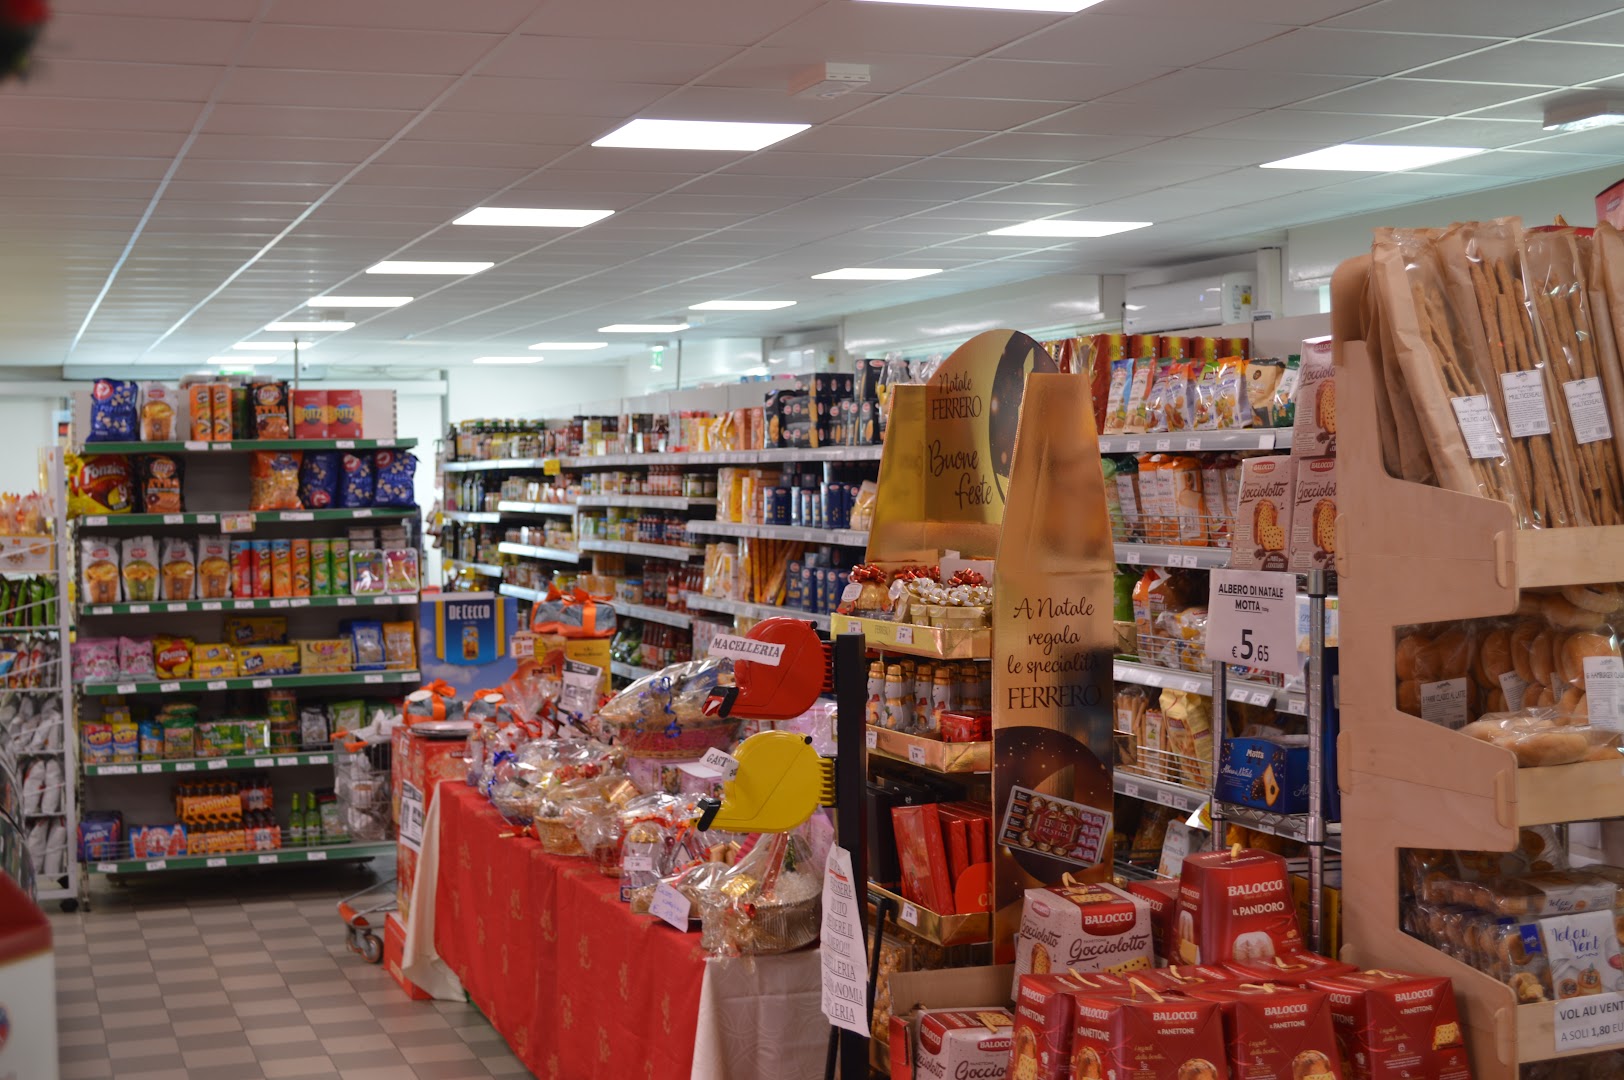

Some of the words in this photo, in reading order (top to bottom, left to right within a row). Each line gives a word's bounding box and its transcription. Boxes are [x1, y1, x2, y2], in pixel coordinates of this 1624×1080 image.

[939, 371, 973, 395] Natale
[303, 408, 322, 419] RITZ
[335, 408, 355, 419] RITZ
[932, 395, 982, 420] FERRERO
[928, 439, 980, 478] Buone
[1218, 583, 1248, 595] ALBERO
[1250, 586, 1257, 595] DI
[1258, 587, 1284, 598] NATALE
[462, 604, 490, 620] CECCO
[1013, 597, 1035, 620] A
[1038, 596, 1095, 618] Natale
[1235, 600, 1261, 611] MOTTA
[1028, 624, 1081, 656] regala
[712, 638, 781, 659] MACELLERIA
[1007, 654, 1023, 674] le
[1026, 652, 1098, 682] specialità
[1008, 685, 1102, 709] FERRERO
[188, 796, 231, 815] CRODINO
[1227, 879, 1284, 897] BALOCCO
[1240, 901, 1285, 917] PANDORO
[1084, 912, 1133, 925] BALOCCO
[1066, 934, 1150, 966] Gocciolotto
[1571, 936, 1599, 953] Vent
[1022, 986, 1046, 1004] BALOCCO
[1330, 993, 1352, 1004] OCCO
[1395, 989, 1434, 1002] BALOCCO
[1021, 1006, 1046, 1025] PANETTONE
[1080, 1005, 1109, 1020] BALOCCO
[1153, 1011, 1198, 1021] BALOCCO
[1264, 1004, 1308, 1016] BALOCCO
[1404, 1005, 1433, 1015] PANETTONE
[1560, 1008, 1580, 1020] VOL
[1582, 1005, 1597, 1017] AU
[1599, 1000, 1624, 1014] VENT
[1273, 1020, 1306, 1029] PANETTONE
[1332, 1013, 1355, 1025] TTONE
[1080, 1026, 1110, 1041] PANETTONE
[1561, 1032, 1568, 1041] A
[1569, 1029, 1589, 1040] SOLI
[1591, 1025, 1611, 1038] 1,80
